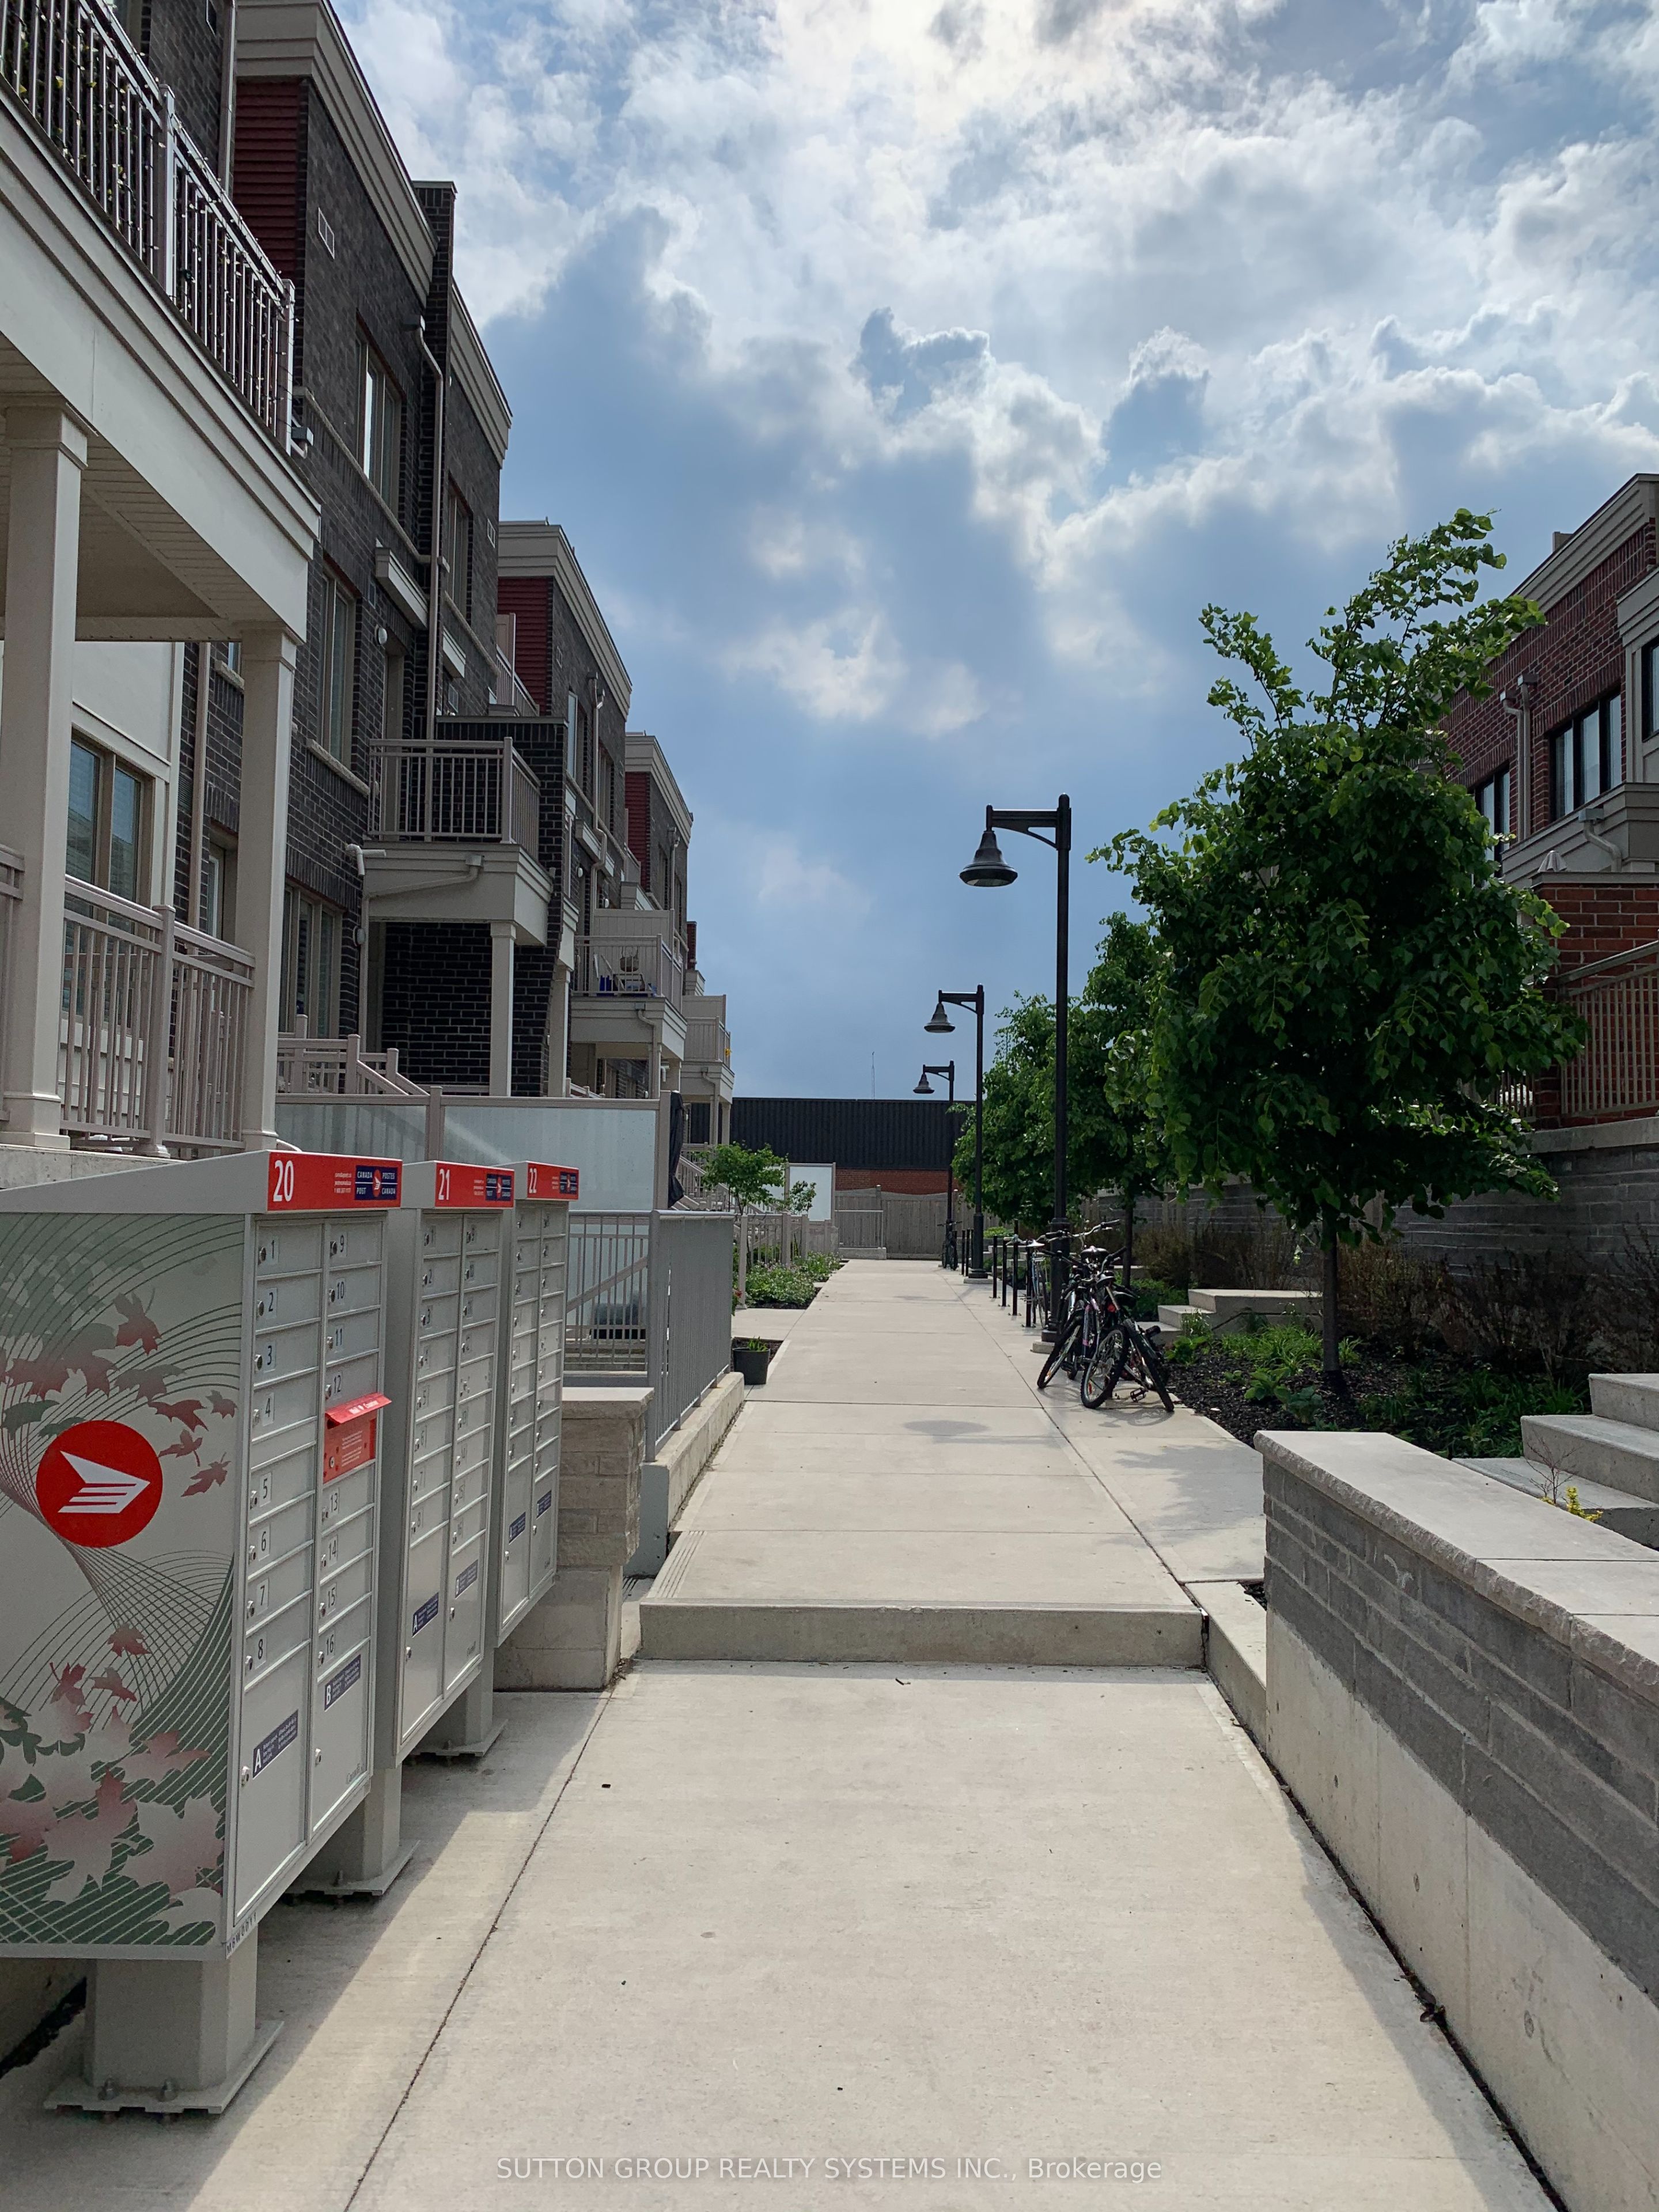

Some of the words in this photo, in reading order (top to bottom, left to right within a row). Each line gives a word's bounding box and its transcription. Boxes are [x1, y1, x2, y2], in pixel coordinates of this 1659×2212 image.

[273, 1160, 294, 1202] 20
[357, 1171, 373, 1179] CANADA
[382, 1172, 396, 1180] POSTES
[438, 1169, 450, 1200] 21
[529, 1167, 537, 1194] 22
[271, 1240, 275, 1259] 1
[340, 1234, 344, 1253] 9
[337, 1281, 344, 1300] 10
[268, 1291, 274, 1312] 2
[335, 1328, 343, 1346] 11
[267, 1345, 272, 1366] 3
[334, 1374, 341, 1393] 12
[265, 1397, 271, 1418] 4
[263, 1478, 268, 1499] 5
[330, 1493, 338, 1512] 13
[261, 1531, 267, 1552] 6
[328, 1540, 336, 1560] 14
[260, 1585, 265, 1606] 7
[328, 1587, 335, 1607] 15
[257, 1638, 263, 1660] 8
[326, 1634, 334, 1655] 16
[326, 1684, 331, 1706] B
[254, 1748, 262, 1773] A
